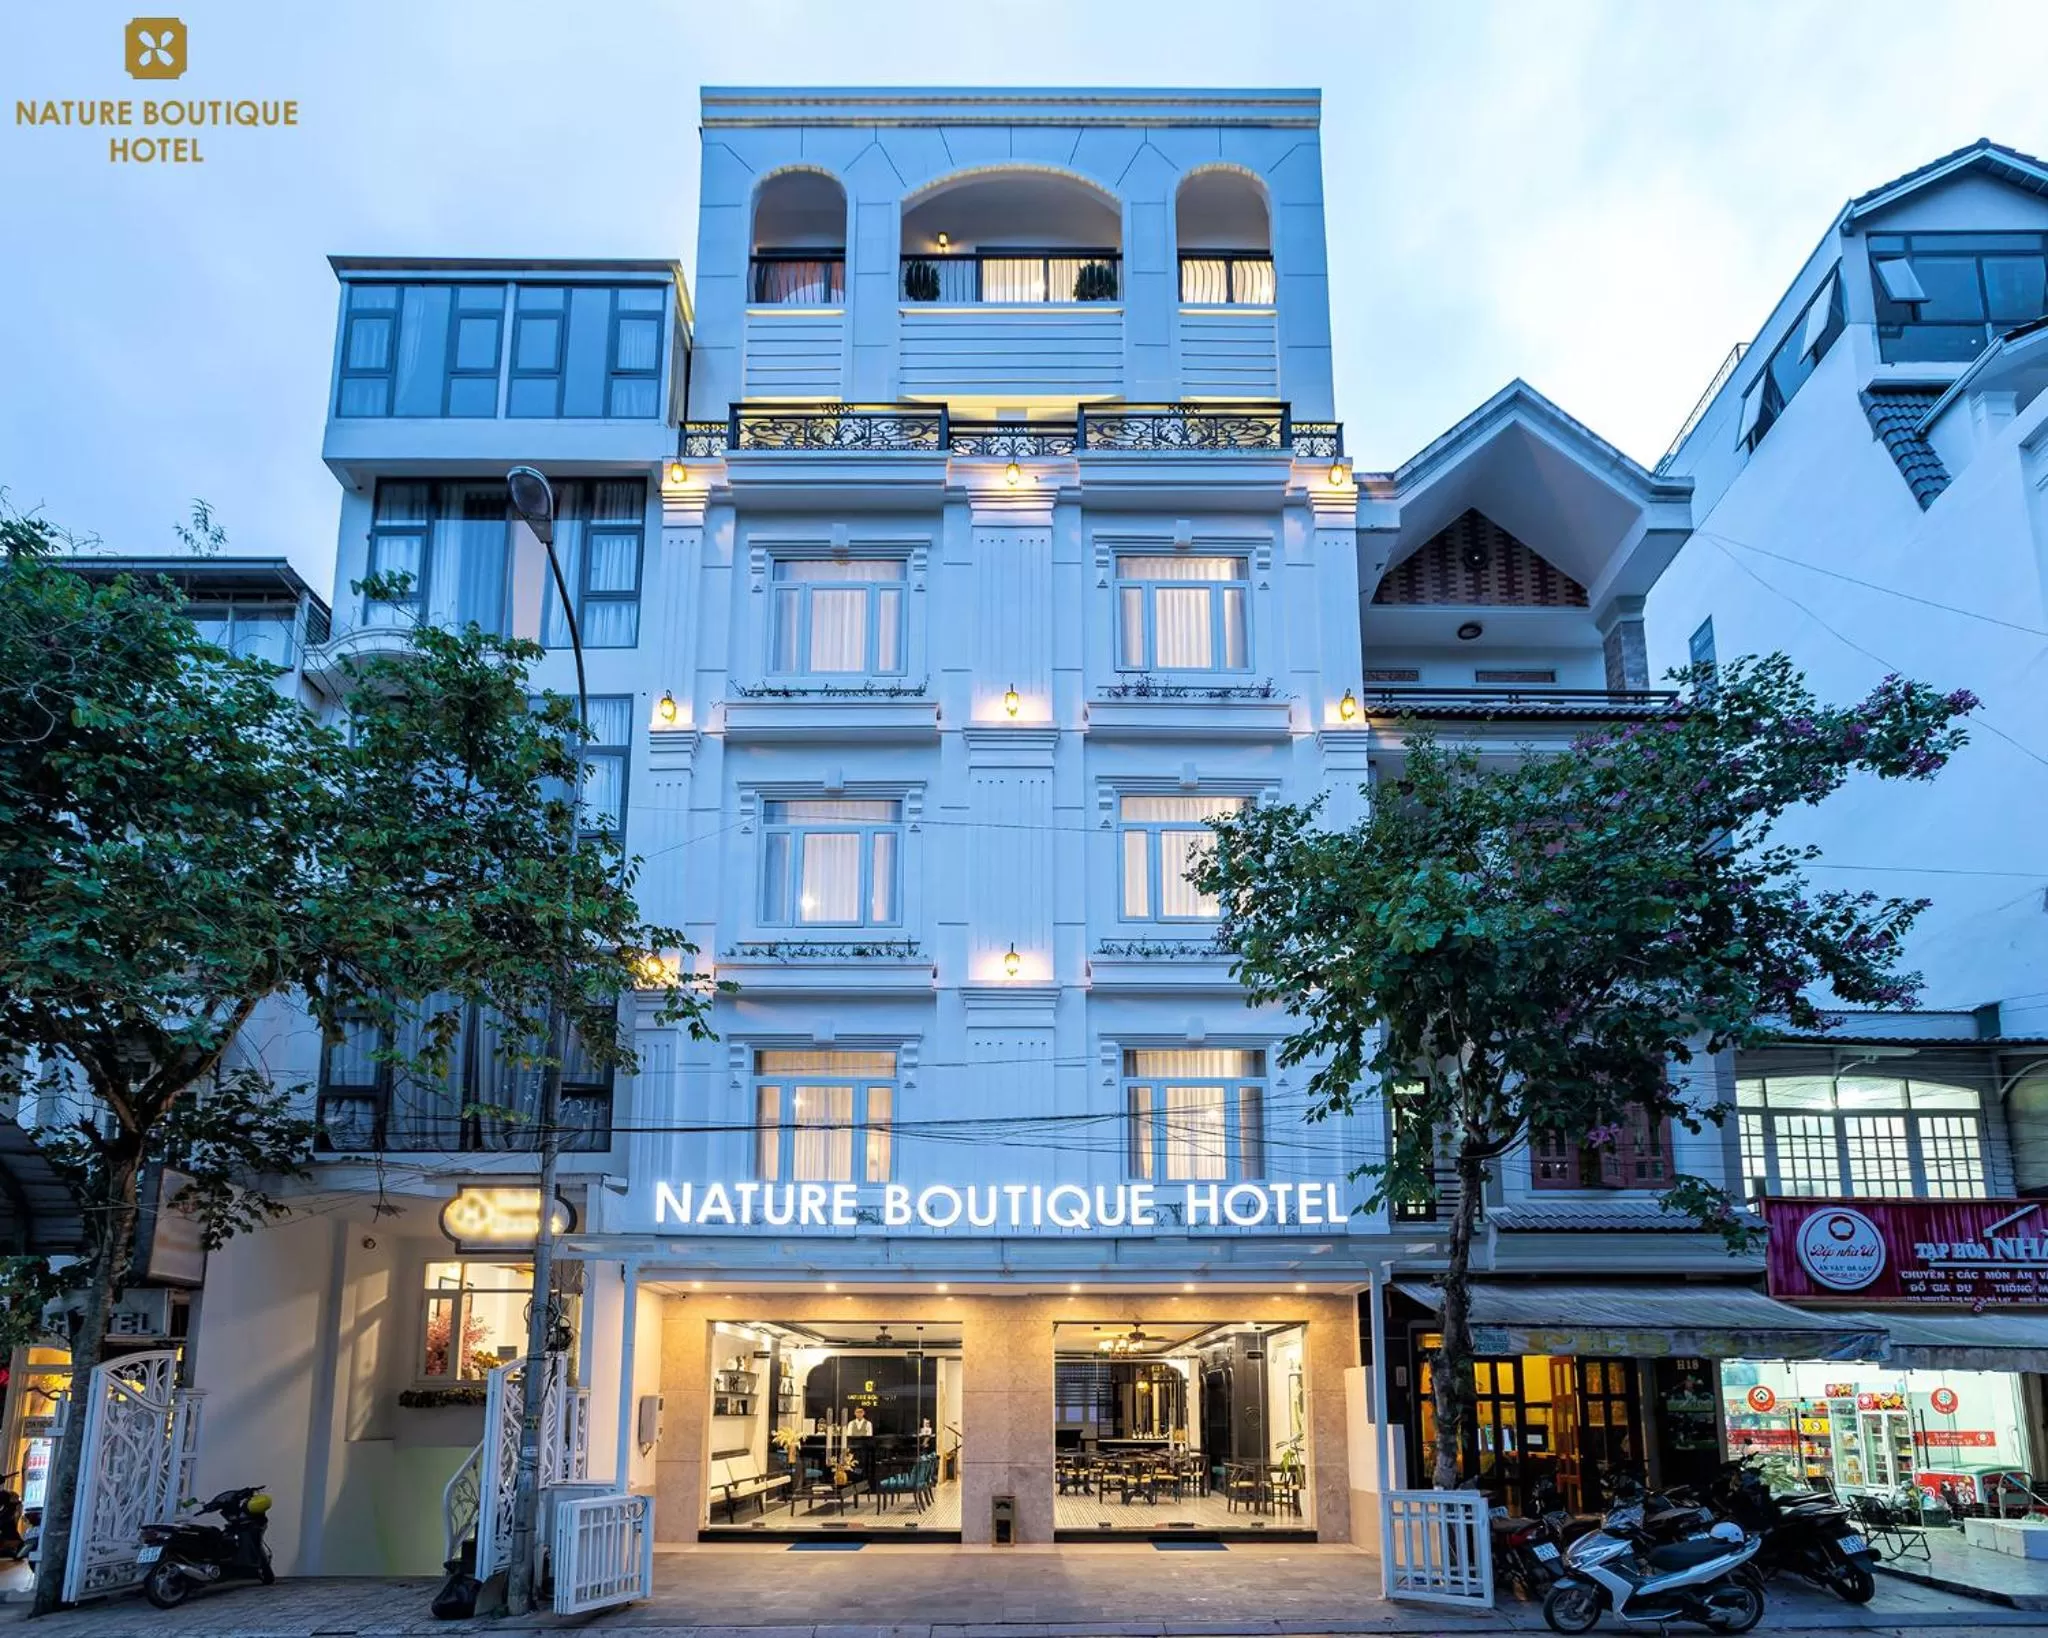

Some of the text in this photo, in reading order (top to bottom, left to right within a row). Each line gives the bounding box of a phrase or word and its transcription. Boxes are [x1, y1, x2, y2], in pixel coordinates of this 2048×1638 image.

[653, 1181, 1349, 1229] NATURE BOUTIQUE HOTEL
[1991, 1229, 2048, 1260] NH
